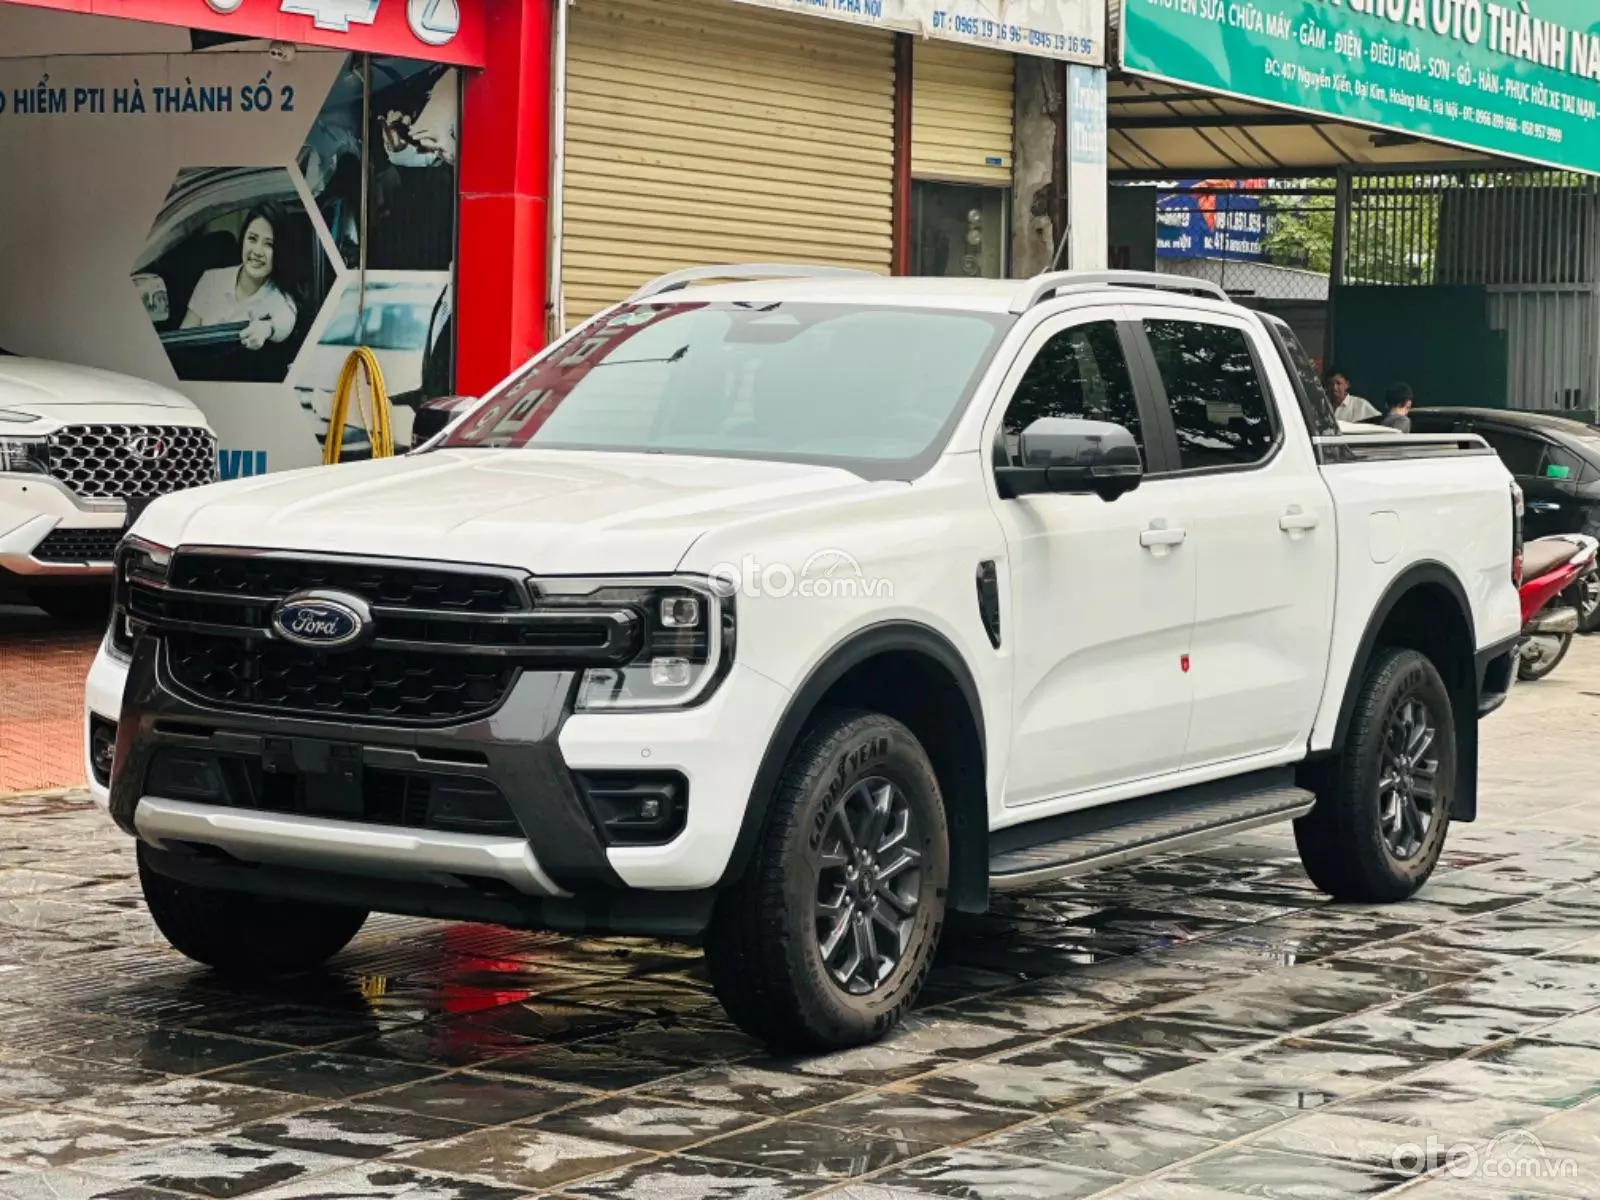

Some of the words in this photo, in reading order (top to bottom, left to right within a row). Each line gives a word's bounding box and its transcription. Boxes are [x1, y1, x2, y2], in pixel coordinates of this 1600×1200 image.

[955, 15, 979, 36] 0965
[981, 19, 993, 38] 19
[996, 24, 1007, 42] 16
[1009, 25, 1022, 43] 96
[1054, 33, 1065, 51] 19
[1068, 36, 1078, 54] 16
[1266, 11, 1292, 41] MÁY
[1334, 29, 1362, 61] ĐIỆN
[1370, 37, 1396, 68] ĐIỀU
[1487, 0, 1566, 71] THÀNH
[13, 73, 67, 114] HIỂM
[73, 87, 105, 114] PTI
[113, 78, 146, 114] HÀ
[152, 76, 233, 113] THÀNH
[240, 70, 273, 112] SỐ
[280, 86, 295, 112] 2
[291, 607, 340, 636] Ford
